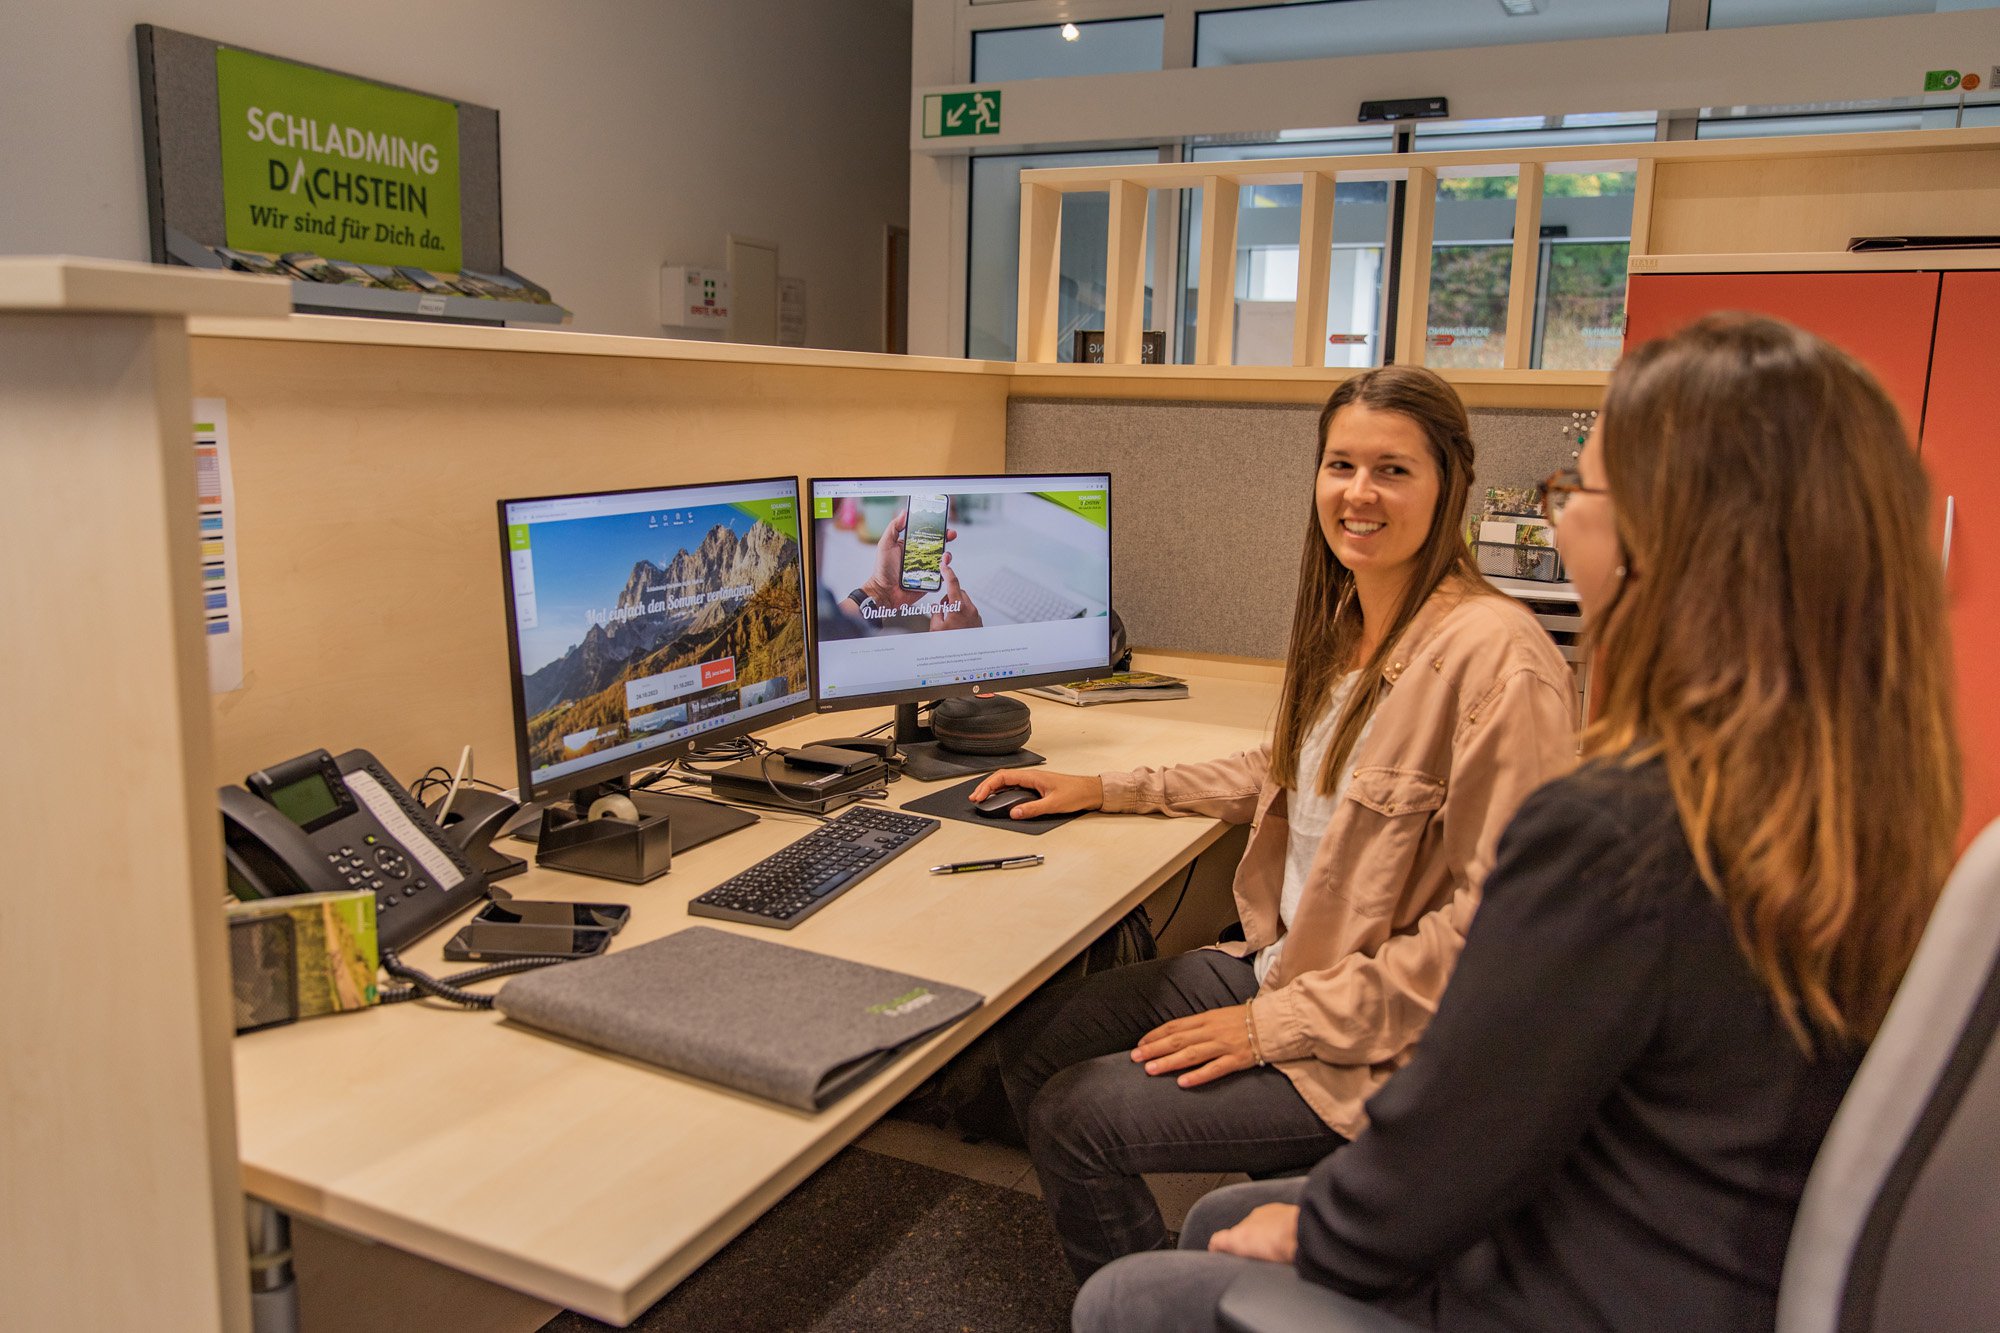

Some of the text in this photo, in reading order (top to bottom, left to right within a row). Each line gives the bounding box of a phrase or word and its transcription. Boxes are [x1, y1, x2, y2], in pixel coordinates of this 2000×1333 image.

[247, 106, 439, 175] SCHLADMING
[269, 157, 428, 218] DACHSTEIN
[250, 205, 445, 250] Wir sind für Dich da.
[585, 608, 607, 624] Mal
[608, 601, 646, 624] einfach
[647, 598, 666, 614] den
[667, 593, 705, 611] Sommer
[862, 601, 961, 620] Online Buchbarkeit
